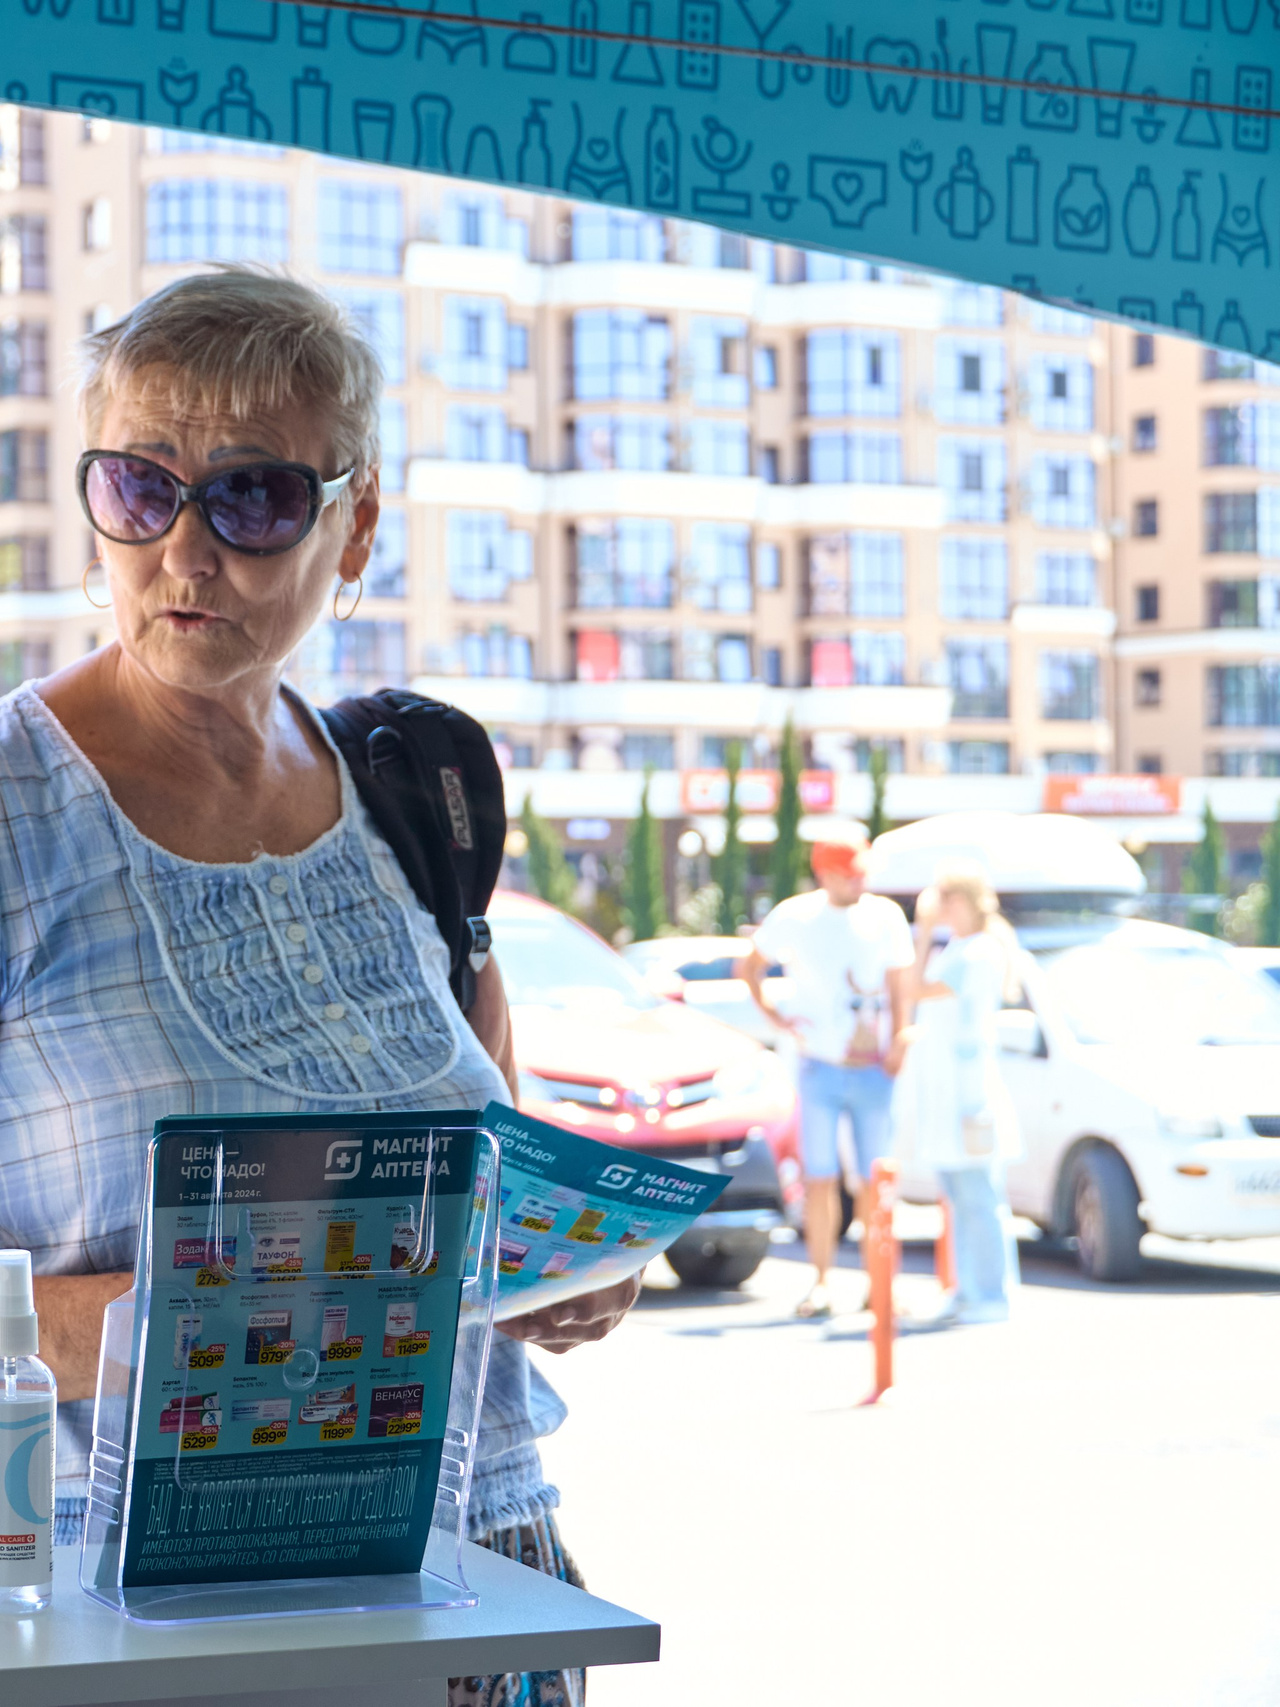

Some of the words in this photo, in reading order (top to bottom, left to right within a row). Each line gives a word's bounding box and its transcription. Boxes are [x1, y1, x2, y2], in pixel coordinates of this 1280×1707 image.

[444, 772, 468, 844] PULSAR
[494, 1121, 529, 1141] ЦЕНА
[373, 1137, 453, 1155] МАГНИТ
[515, 1143, 556, 1164] НАДО!
[181, 1165, 212, 1179] ЧТО
[213, 1163, 266, 1179] НАДО!
[641, 1172, 708, 1194] МАГНИТ
[234, 1189, 255, 1198] 2024
[632, 1185, 696, 1206] АПТЕКА
[257, 1250, 294, 1261] ТАУФОН
[250, 1316, 286, 1325] Фосфоглив
[375, 1389, 421, 1402] ВЕНАРУС
[142, 1538, 192, 1554] ИМЕЮТСЯ
[303, 1527, 335, 1544] ПЕРЕД
[336, 1522, 409, 1541] ПРИМЕНЕНИЕМ
[137, 1549, 259, 1571] ПРОКОНСУЛЬТИРУЙТЕСЬ
[262, 1550, 277, 1564] СО
[279, 1544, 360, 1563] СПЕЦИАЛИСТОМ
